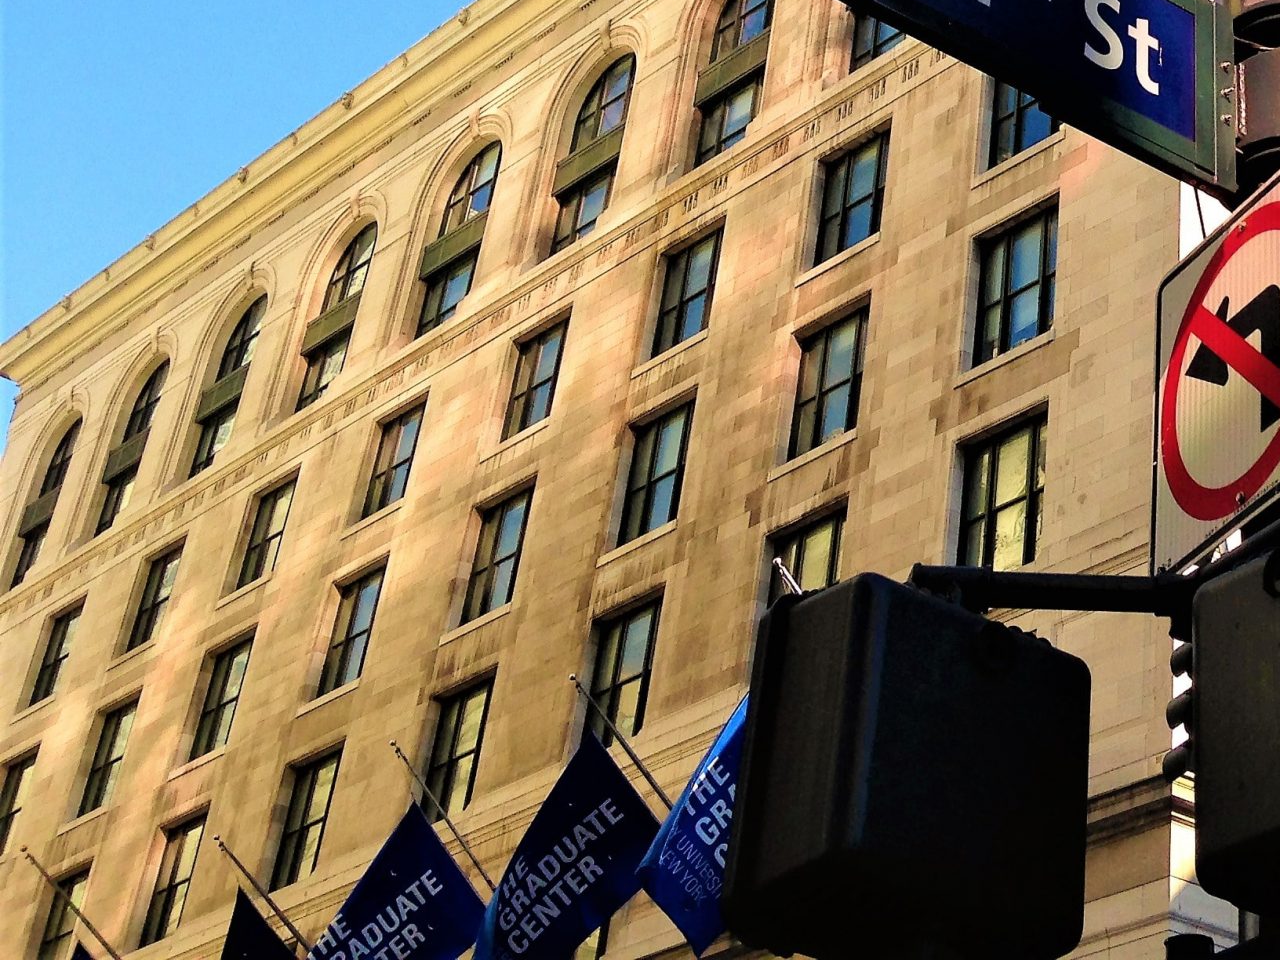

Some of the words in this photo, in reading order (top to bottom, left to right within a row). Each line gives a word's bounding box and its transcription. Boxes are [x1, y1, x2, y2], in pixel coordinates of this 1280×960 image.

[499, 855, 528, 902] HE
[500, 798, 624, 931] GRADUATE
[508, 855, 603, 953] CENTER
